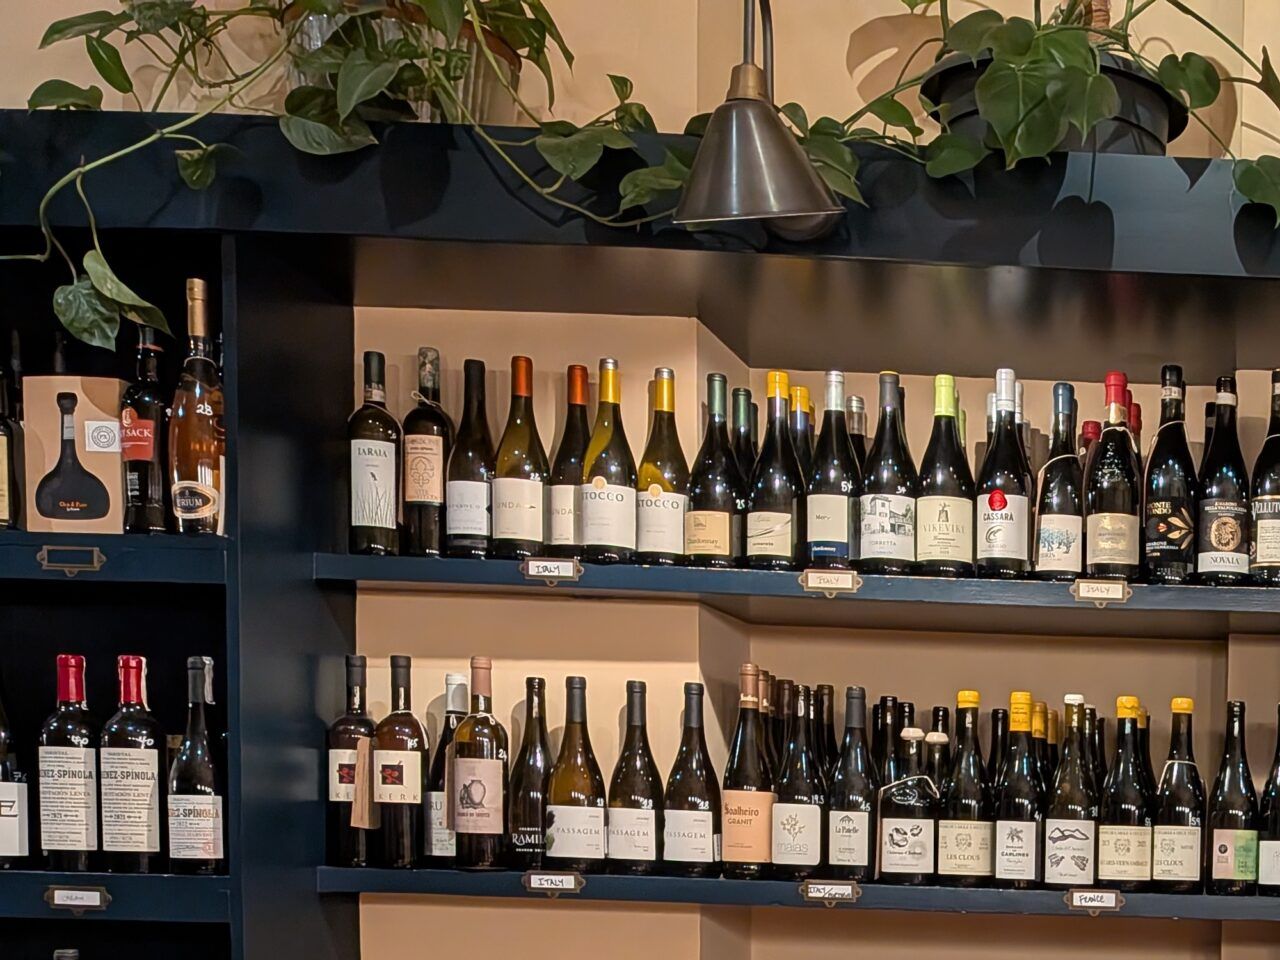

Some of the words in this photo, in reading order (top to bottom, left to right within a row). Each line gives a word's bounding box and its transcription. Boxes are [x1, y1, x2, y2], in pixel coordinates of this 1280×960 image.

[196, 403, 213, 416] 28
[535, 564, 560, 574] ITALY
[724, 803, 760, 818] Soalheiro
[538, 877, 564, 887] ITALY
